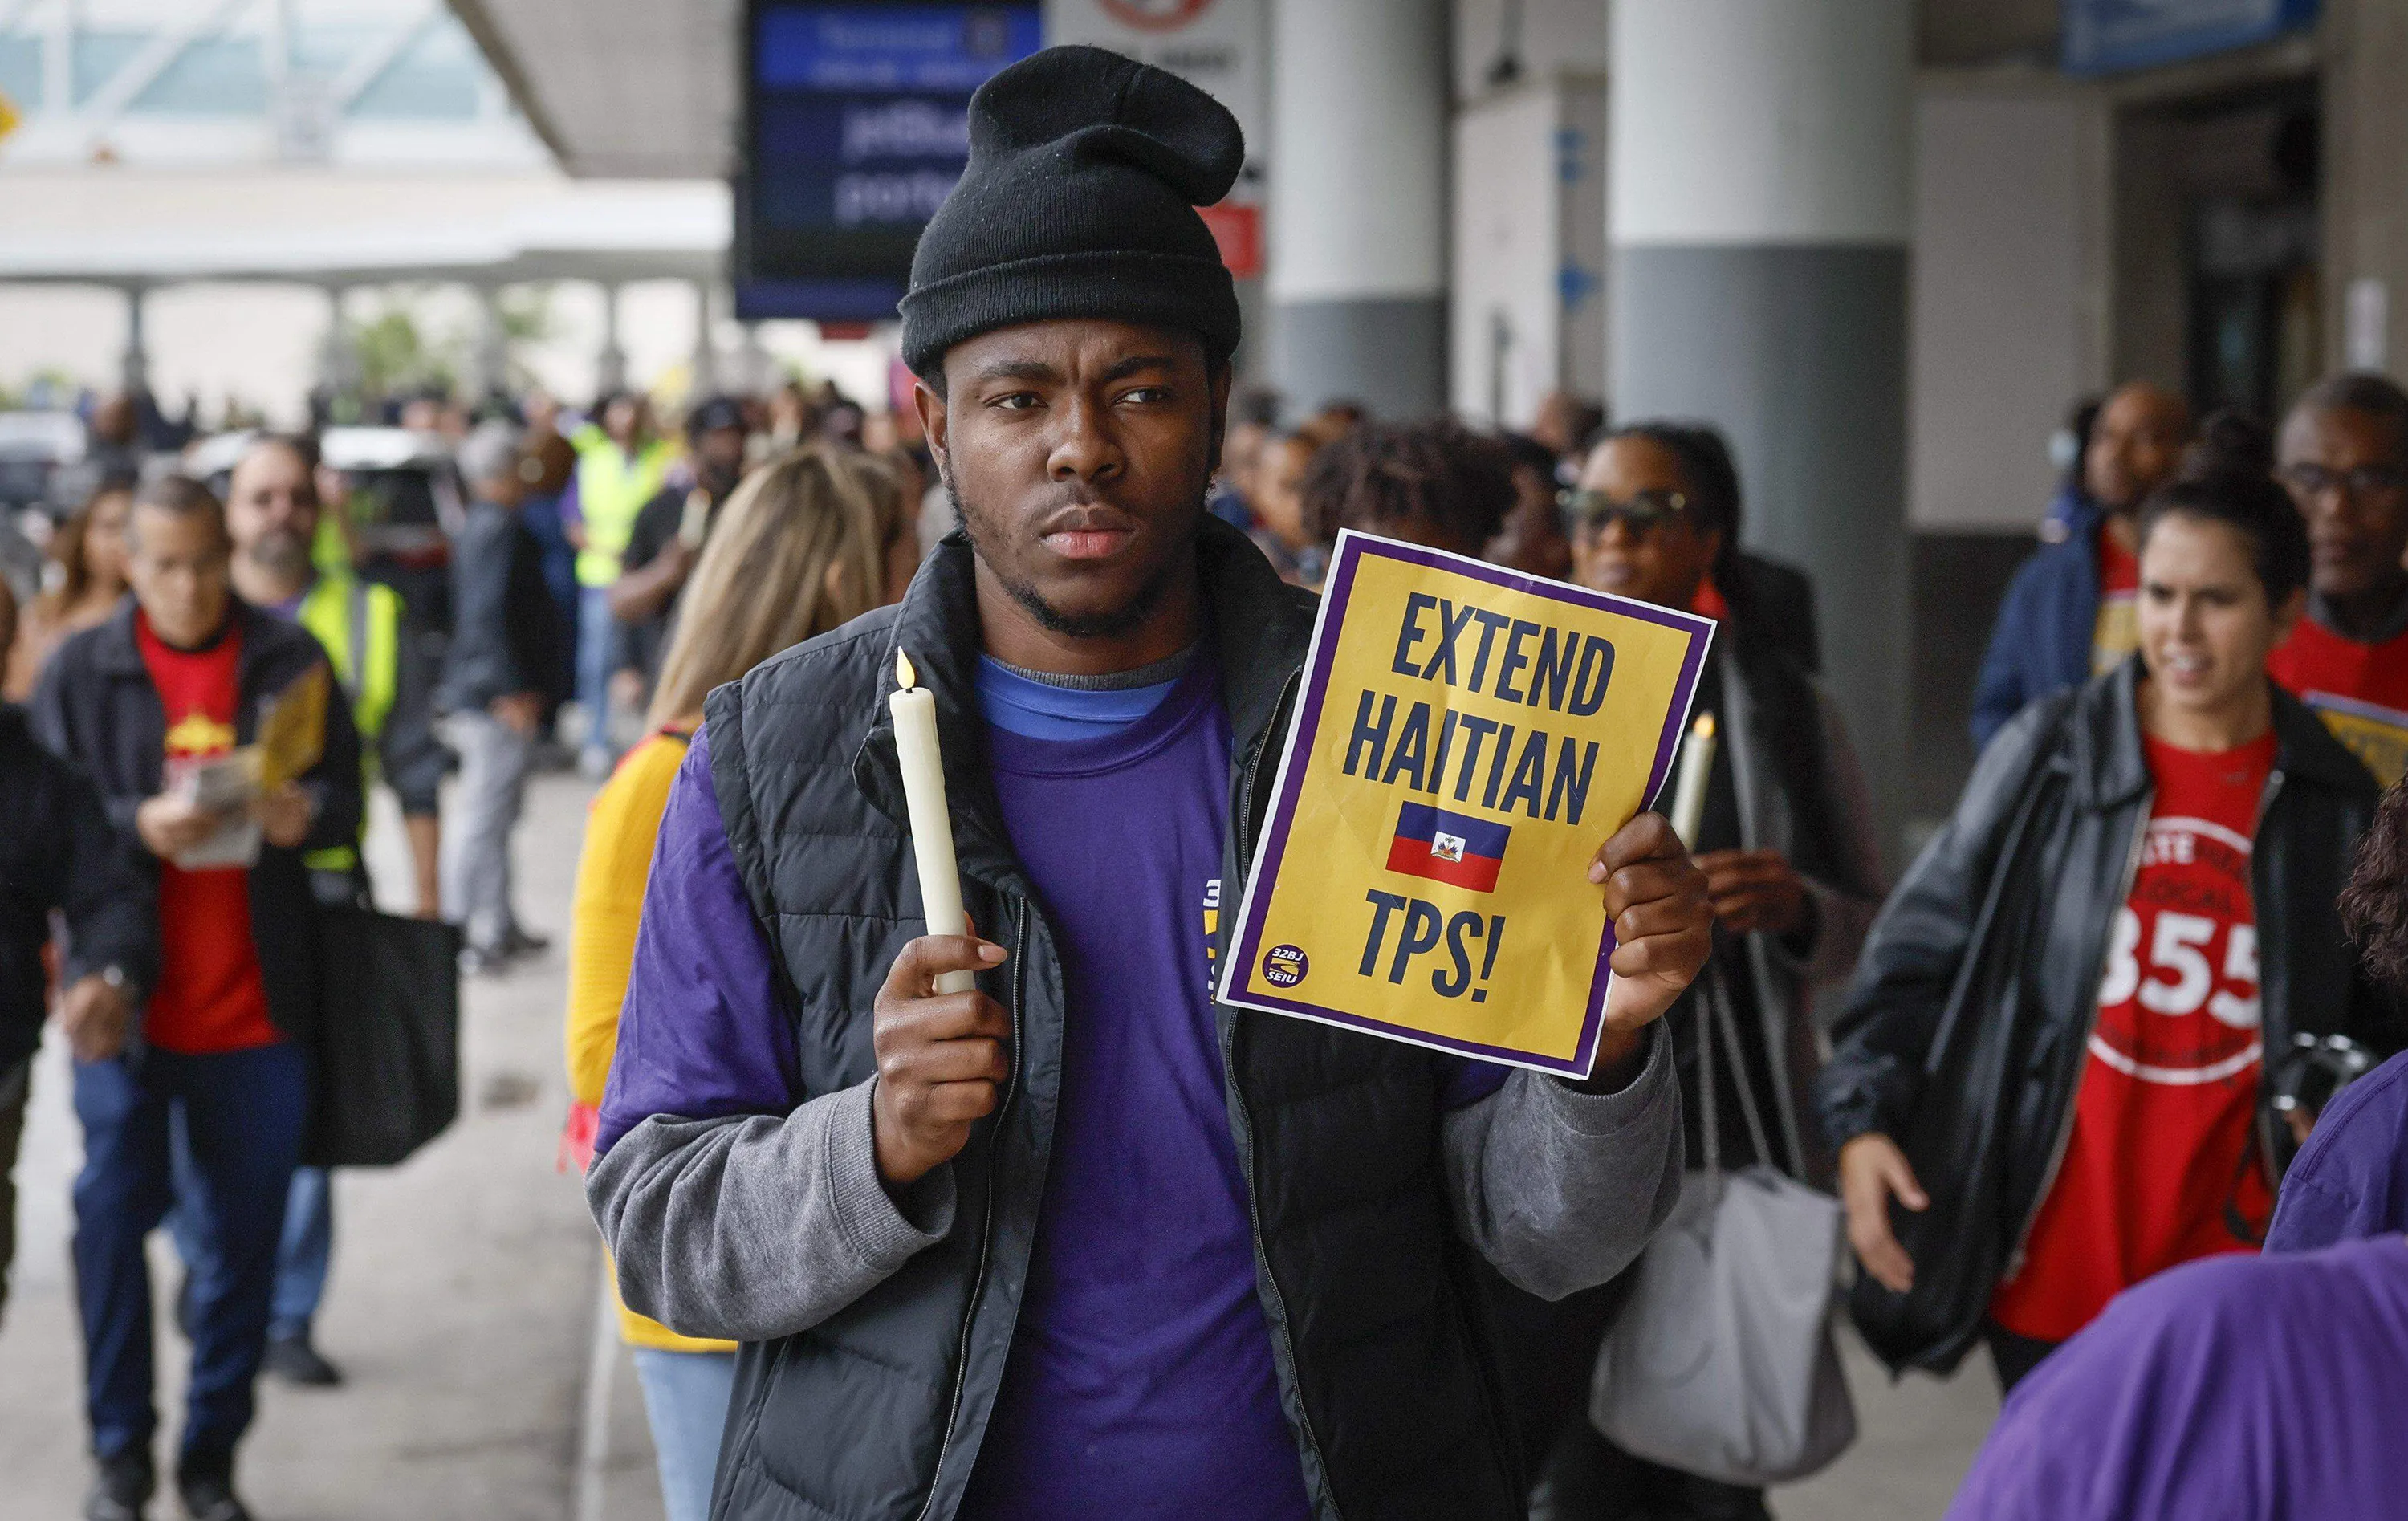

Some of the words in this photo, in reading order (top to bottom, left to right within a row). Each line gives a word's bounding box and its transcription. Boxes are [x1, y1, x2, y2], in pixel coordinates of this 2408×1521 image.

[1391, 592, 1616, 717] EXTEND
[1342, 689, 1601, 826] HAITIAN
[1266, 970, 1299, 984] SEIU
[1271, 947, 1304, 962] 32BJ
[1357, 888, 1506, 1004] TPS!
